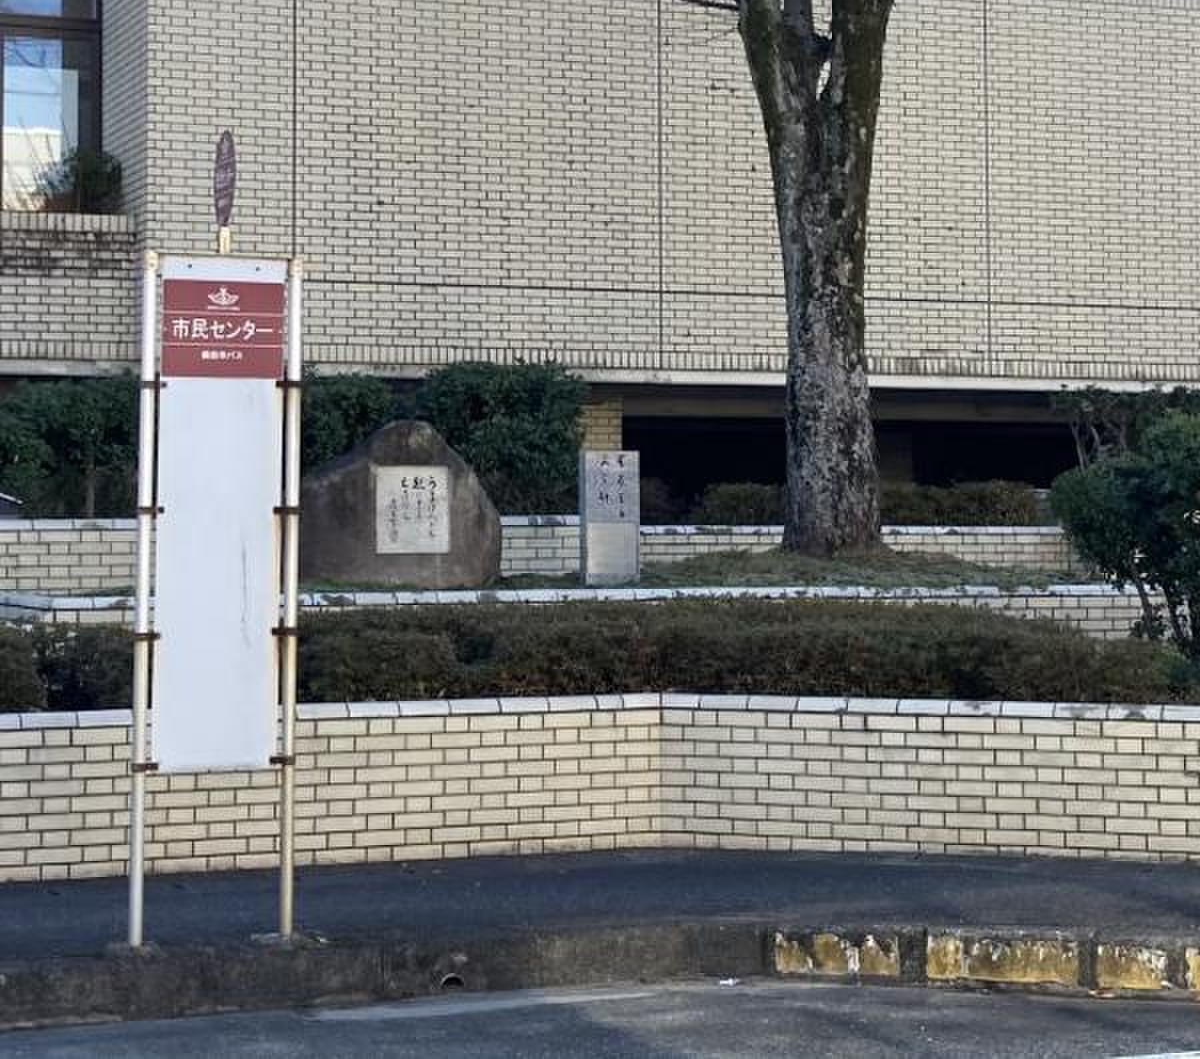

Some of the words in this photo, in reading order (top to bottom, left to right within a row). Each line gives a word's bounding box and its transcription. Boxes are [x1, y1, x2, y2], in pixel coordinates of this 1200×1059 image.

[172, 318, 273, 340] 市民センター
